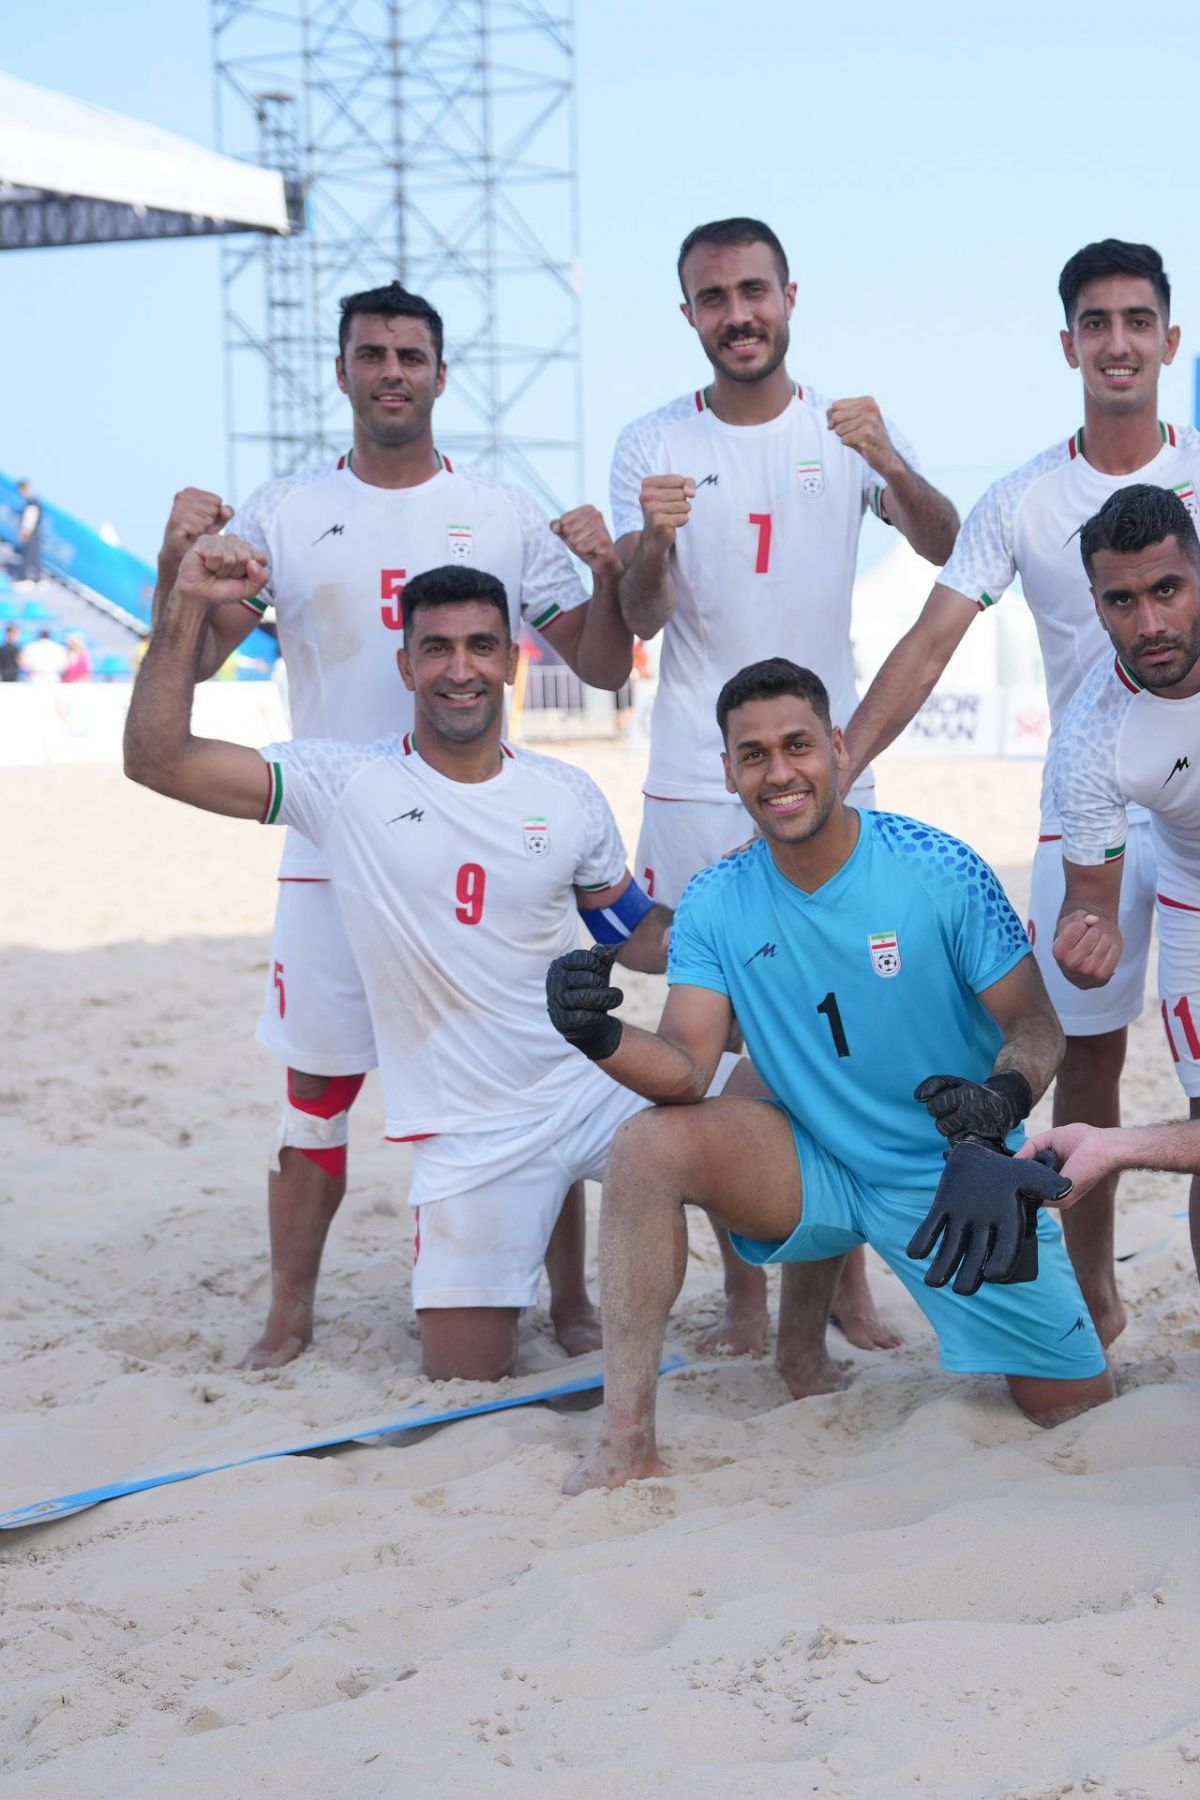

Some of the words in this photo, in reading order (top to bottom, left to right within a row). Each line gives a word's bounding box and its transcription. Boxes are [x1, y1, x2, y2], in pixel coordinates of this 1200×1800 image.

[748, 512, 772, 574] 7
[380, 569, 406, 631] 5
[455, 862, 487, 925] 9
[816, 992, 851, 1058] 1
